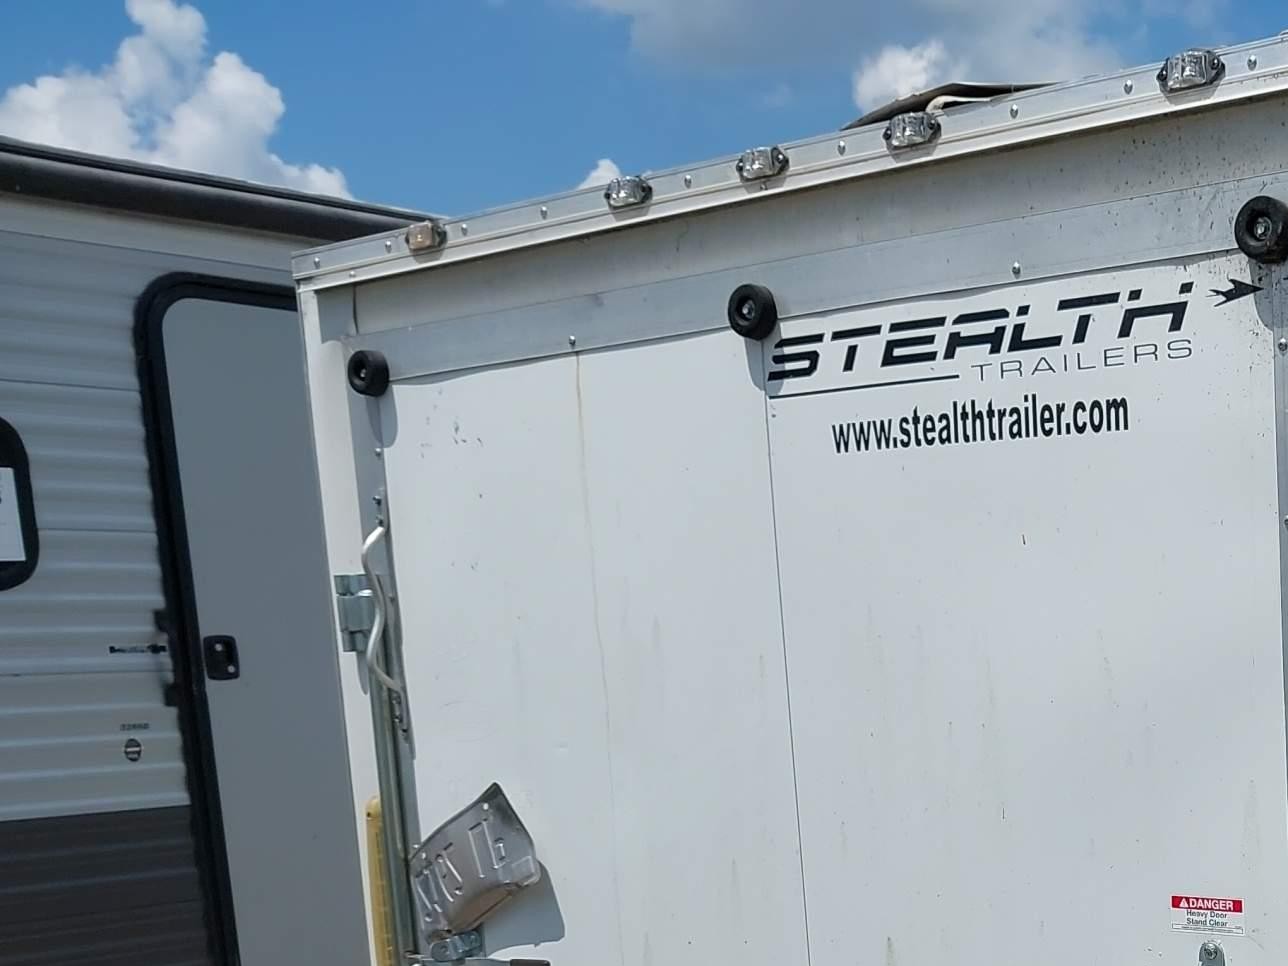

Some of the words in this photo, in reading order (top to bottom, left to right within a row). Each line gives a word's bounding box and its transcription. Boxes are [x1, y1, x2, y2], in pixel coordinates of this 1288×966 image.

[768, 281, 1195, 382] STEALTH
[970, 338, 1193, 382] TRAILERS
[831, 393, 1130, 455] www.stealthtrailer.com
[1186, 909, 1208, 919] Heavy
[1210, 911, 1228, 919] Door
[1189, 898, 1234, 911] DANGER
[1186, 917, 1208, 926] Stand
[1209, 919, 1228, 927] Clear
